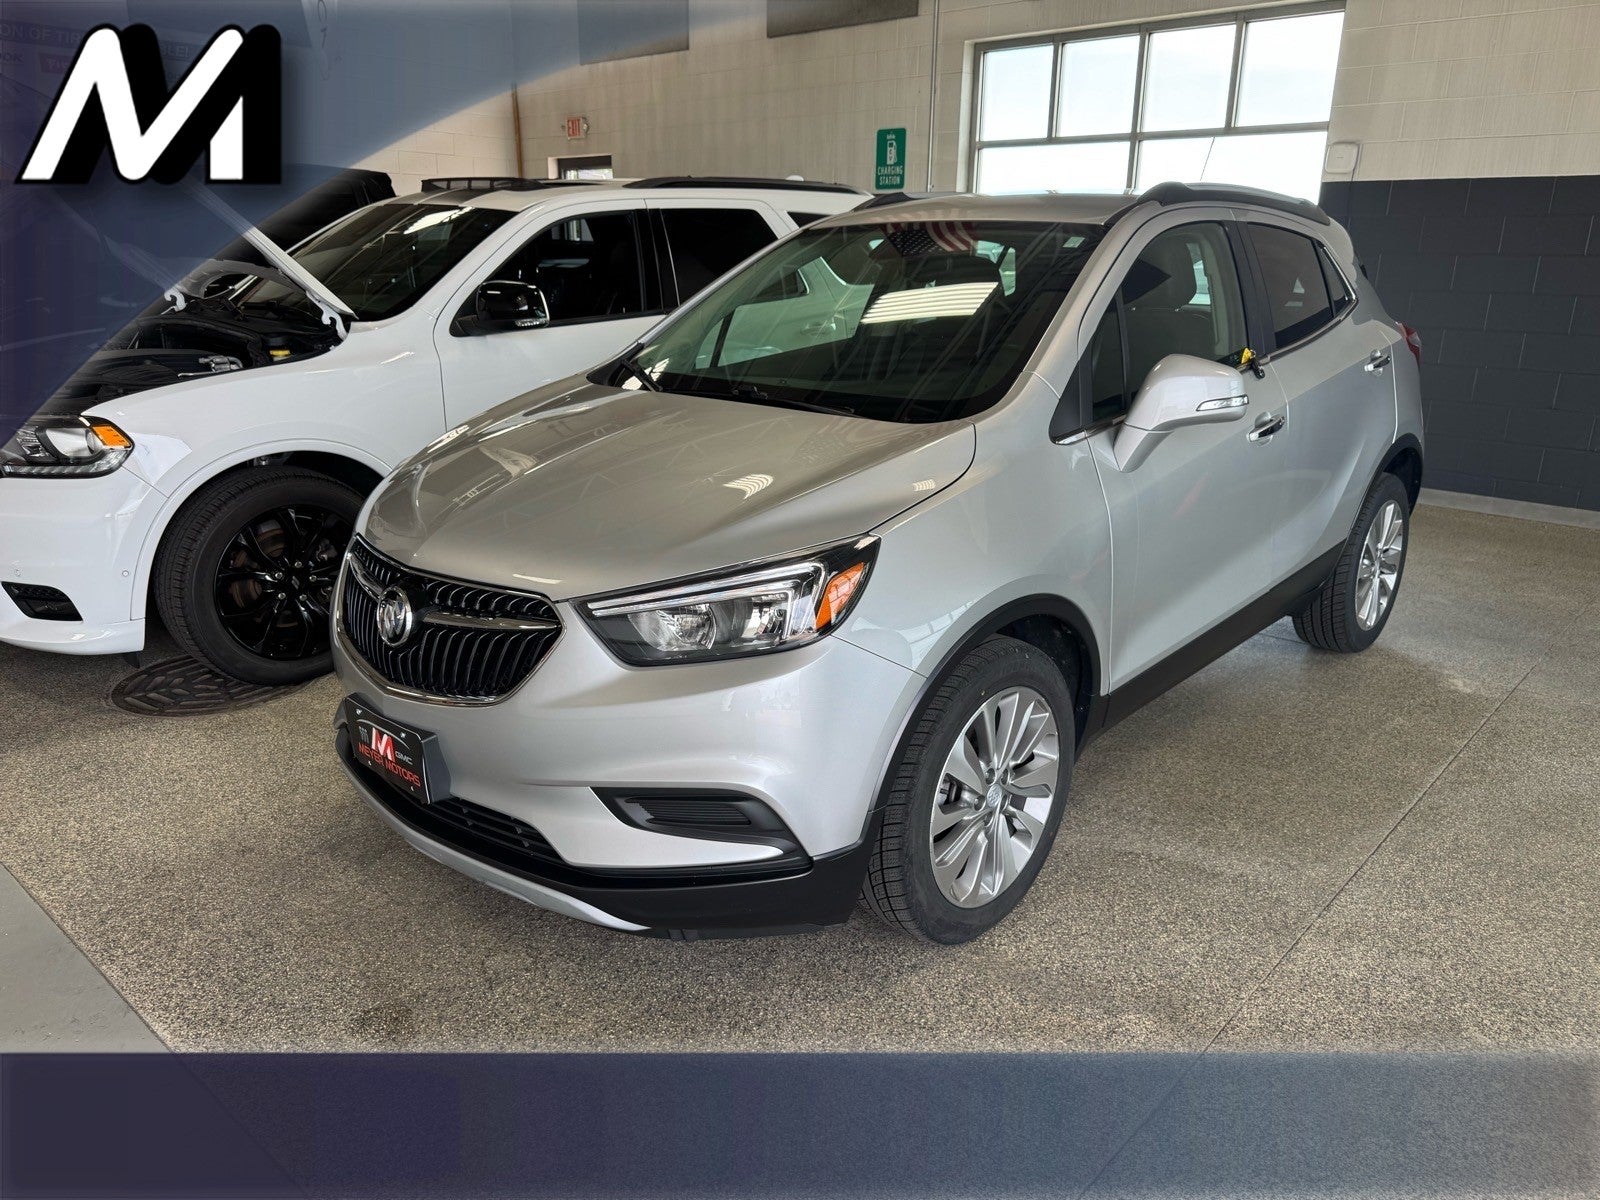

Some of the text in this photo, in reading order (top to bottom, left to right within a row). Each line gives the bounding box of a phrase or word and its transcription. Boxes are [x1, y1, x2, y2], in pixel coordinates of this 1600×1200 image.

[878, 165, 903, 175] CHARGING
[879, 176, 900, 185] STATION
[395, 750, 413, 766] GMC
[358, 743, 421, 788] MEYER MOTORS
